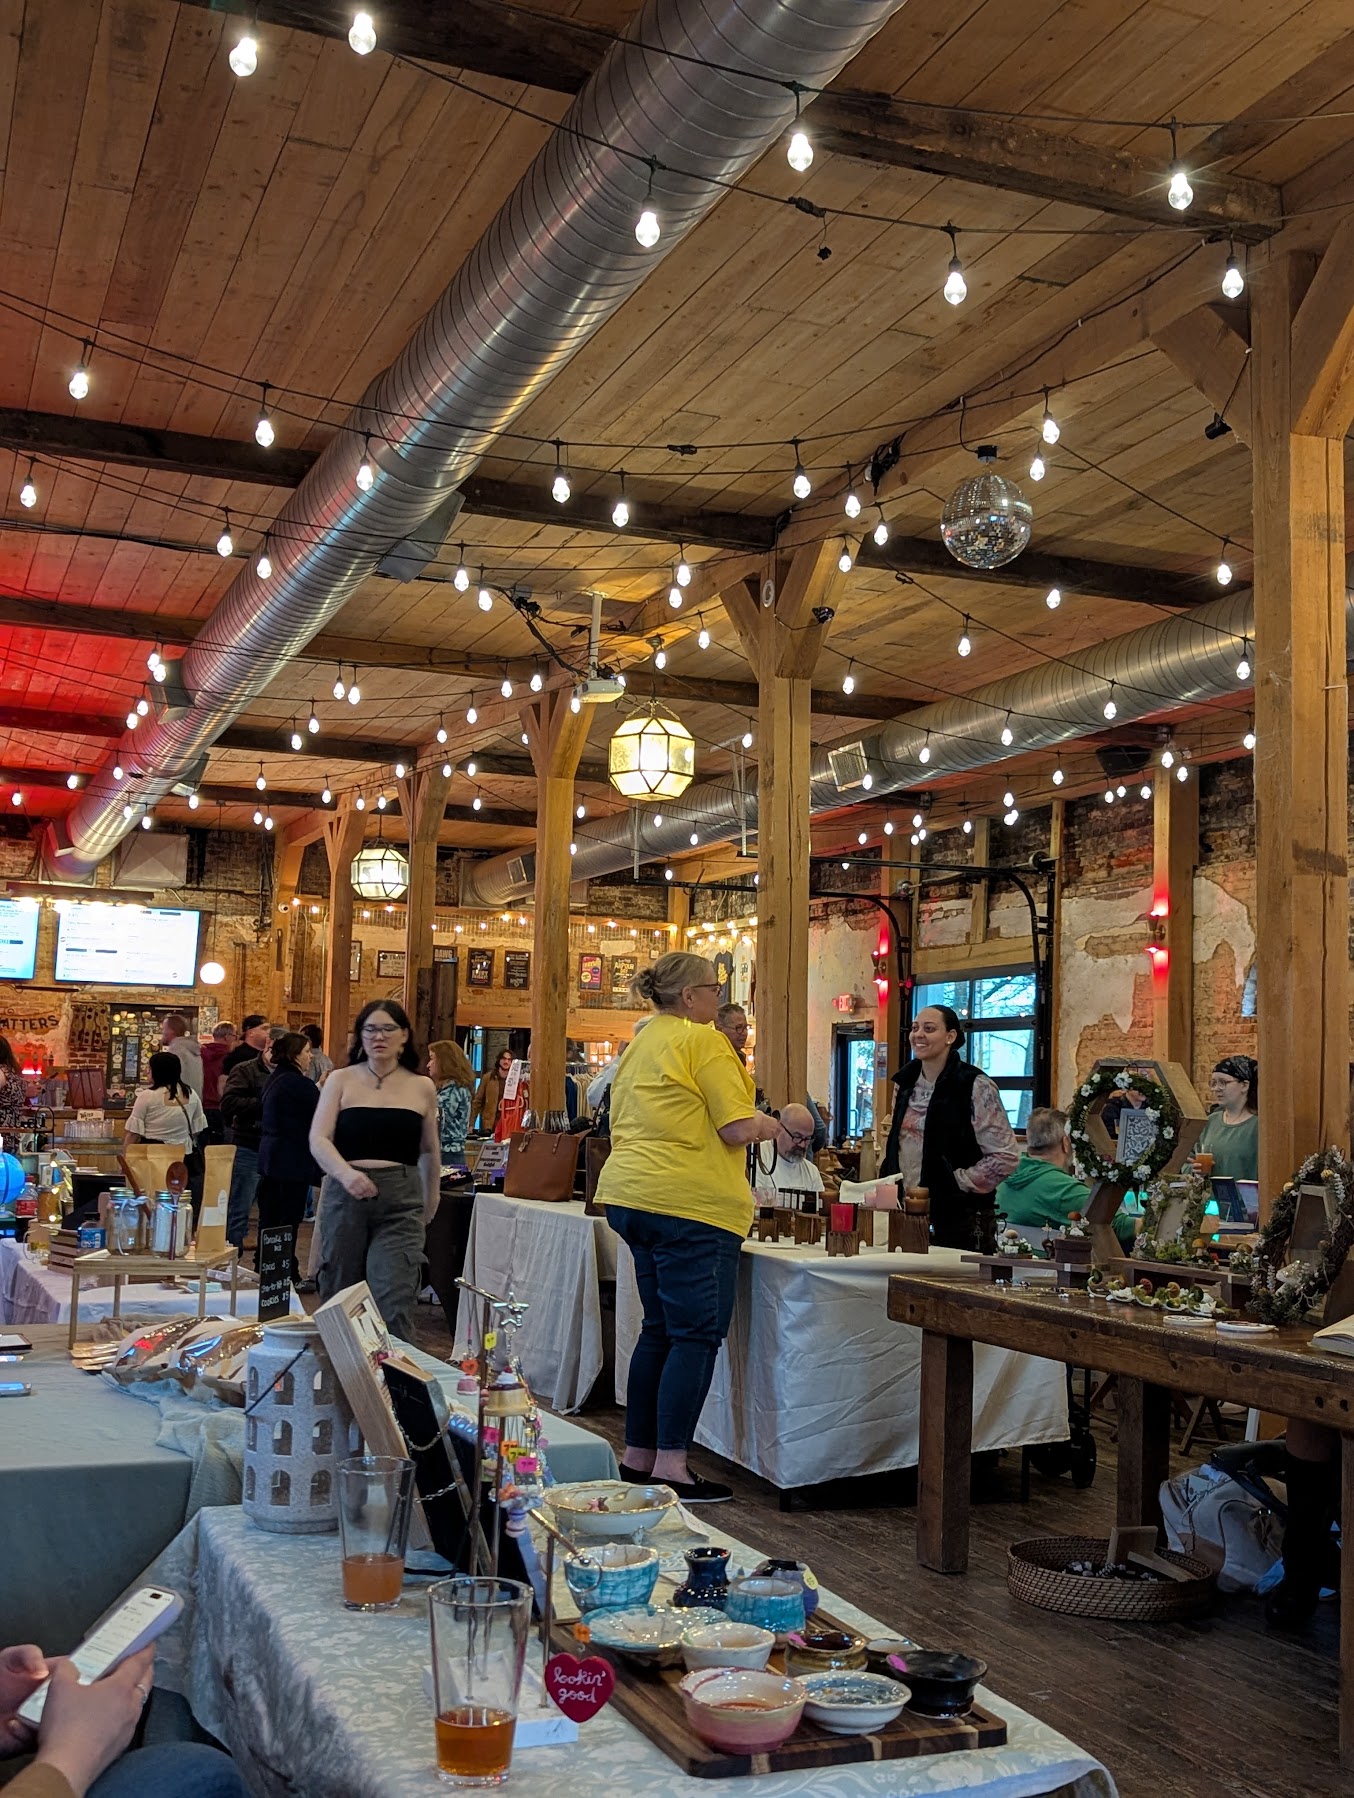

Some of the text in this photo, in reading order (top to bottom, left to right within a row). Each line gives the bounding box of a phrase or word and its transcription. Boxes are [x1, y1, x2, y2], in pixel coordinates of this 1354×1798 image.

[838, 995, 850, 1012] EXIT
[553, 1666, 607, 1686] lookin'
[558, 1687, 597, 1704] good
